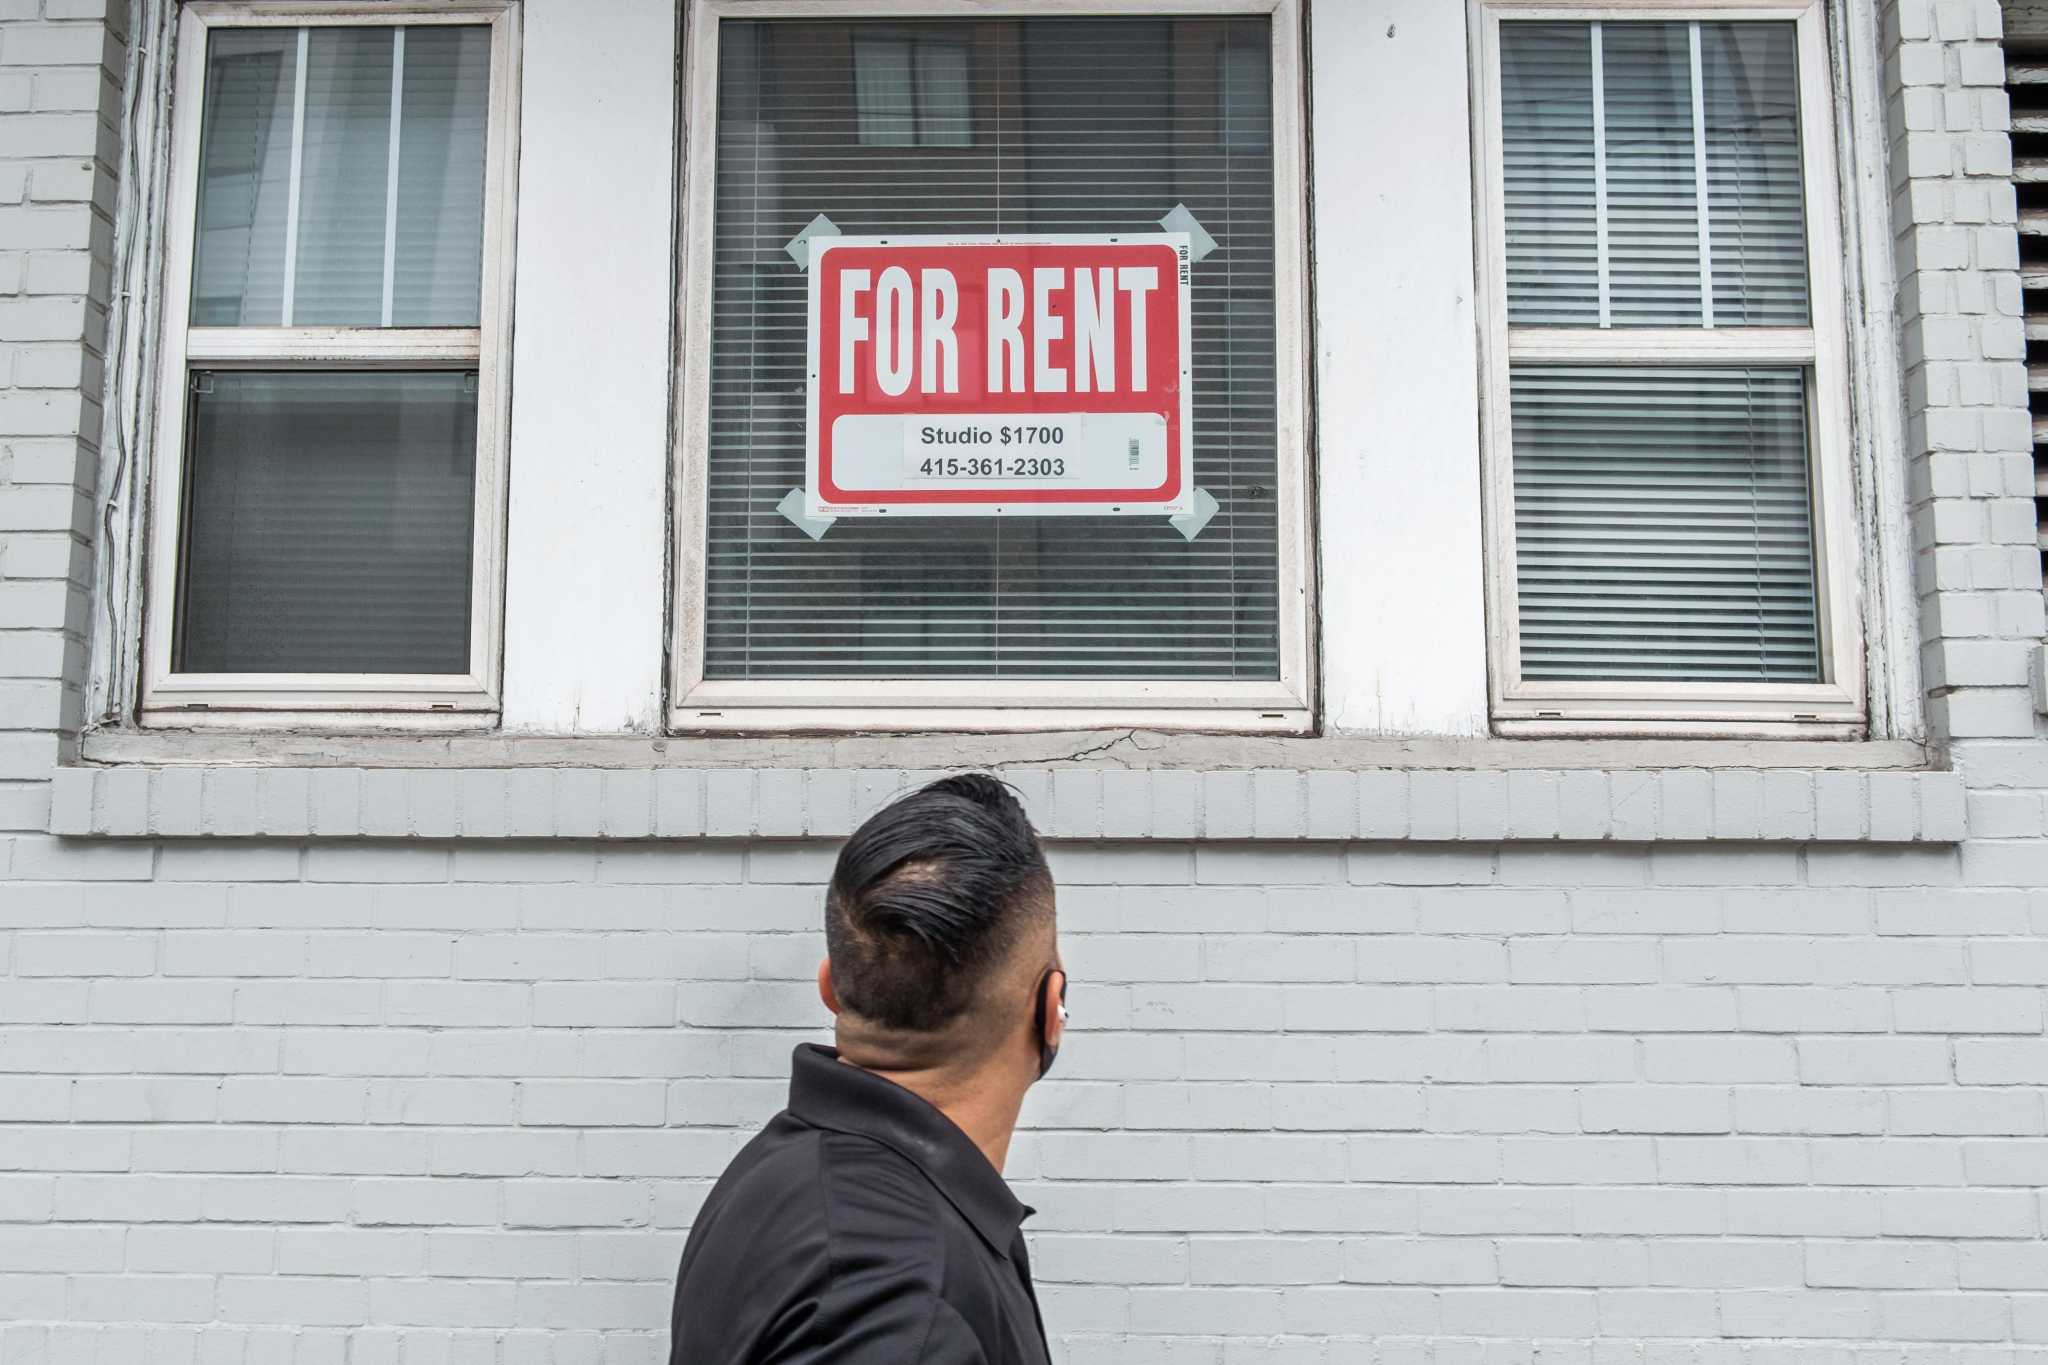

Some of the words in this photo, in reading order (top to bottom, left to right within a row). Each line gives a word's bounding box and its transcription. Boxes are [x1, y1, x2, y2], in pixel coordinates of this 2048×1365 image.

[1179, 245, 1189, 261] FOR
[1179, 264, 1189, 286] RENT
[838, 265, 959, 397] FOR
[987, 266, 1159, 393] RENT
[920, 426, 993, 445] Studio
[999, 425, 1064, 446] $1700
[920, 458, 1065, 477] 415-361-2303
